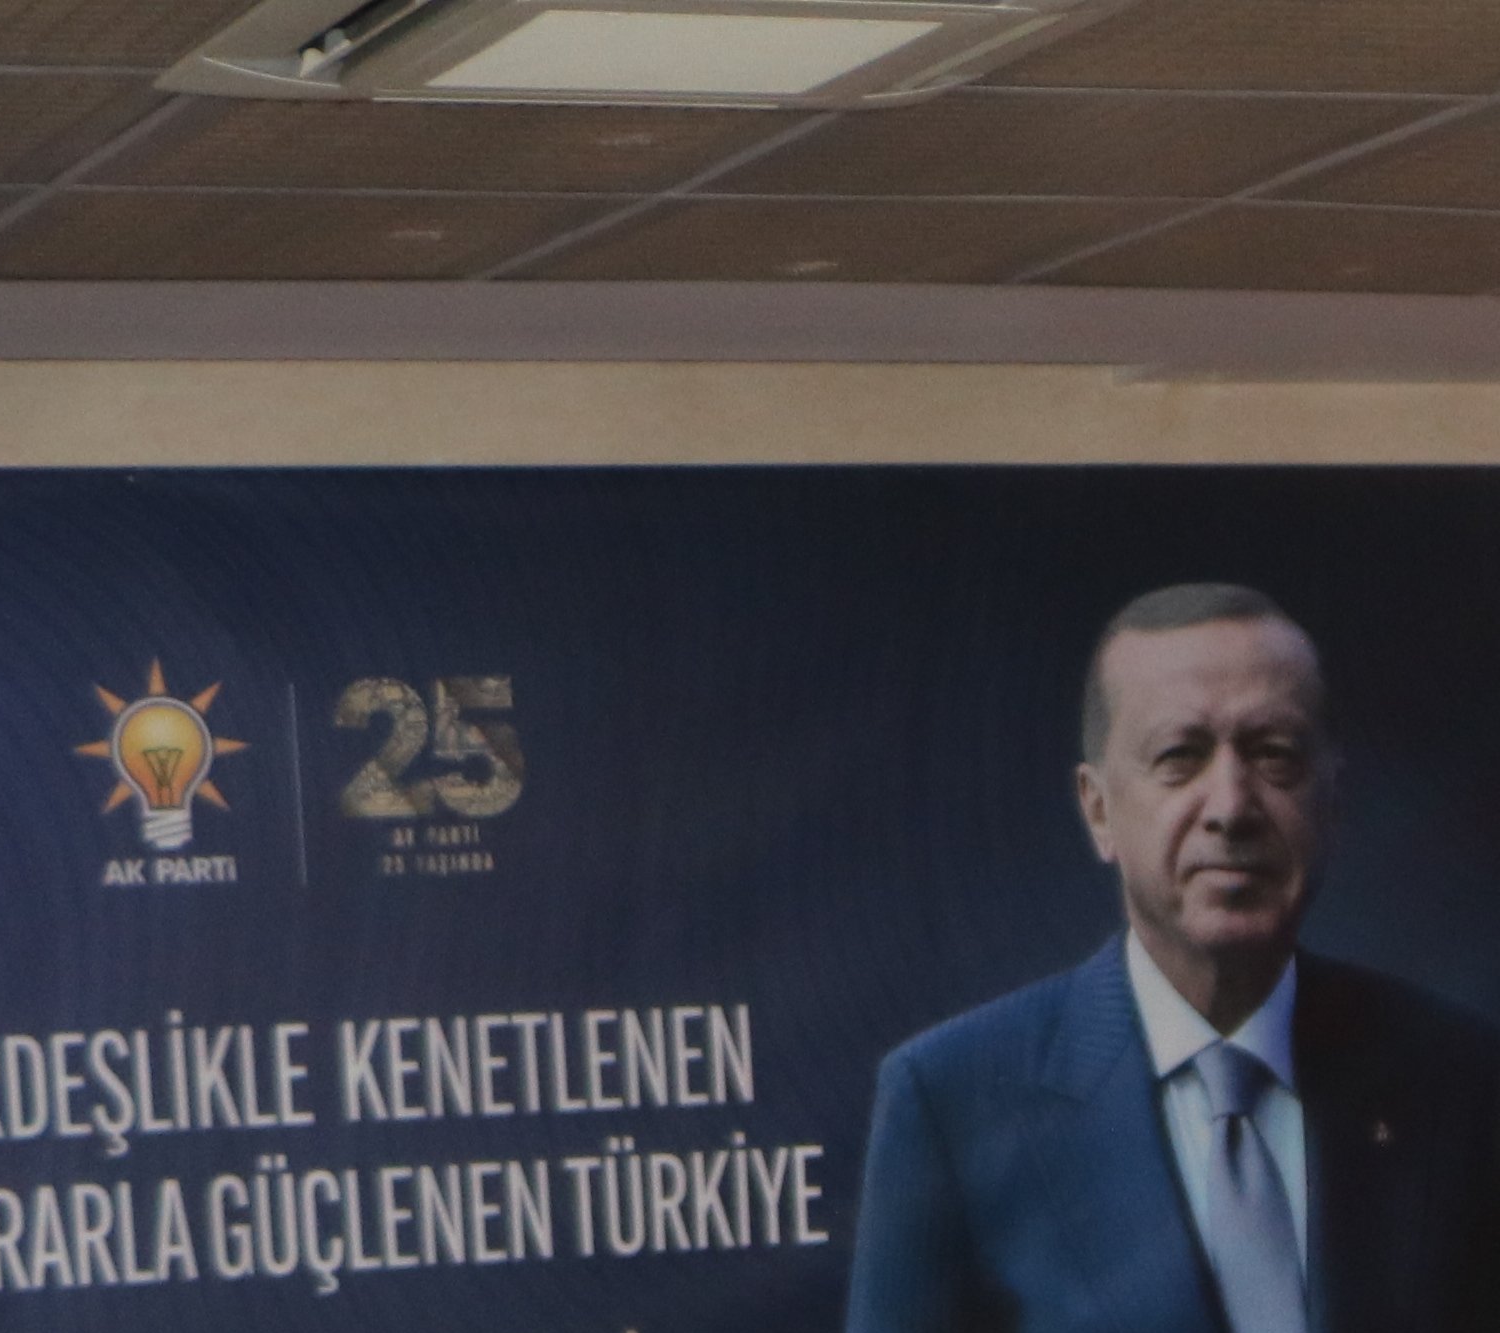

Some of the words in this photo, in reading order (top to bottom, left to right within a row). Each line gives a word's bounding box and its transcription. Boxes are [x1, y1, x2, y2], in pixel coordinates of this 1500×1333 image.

[334, 677, 524, 817] 25
[104, 859, 145, 886] AK
[156, 854, 237, 884] PARTİ
[340, 1004, 756, 1121] KENETLENEN
[209, 1155, 553, 1293] GÜÇLENEN
[562, 1131, 829, 1253] TÜRKİYE
